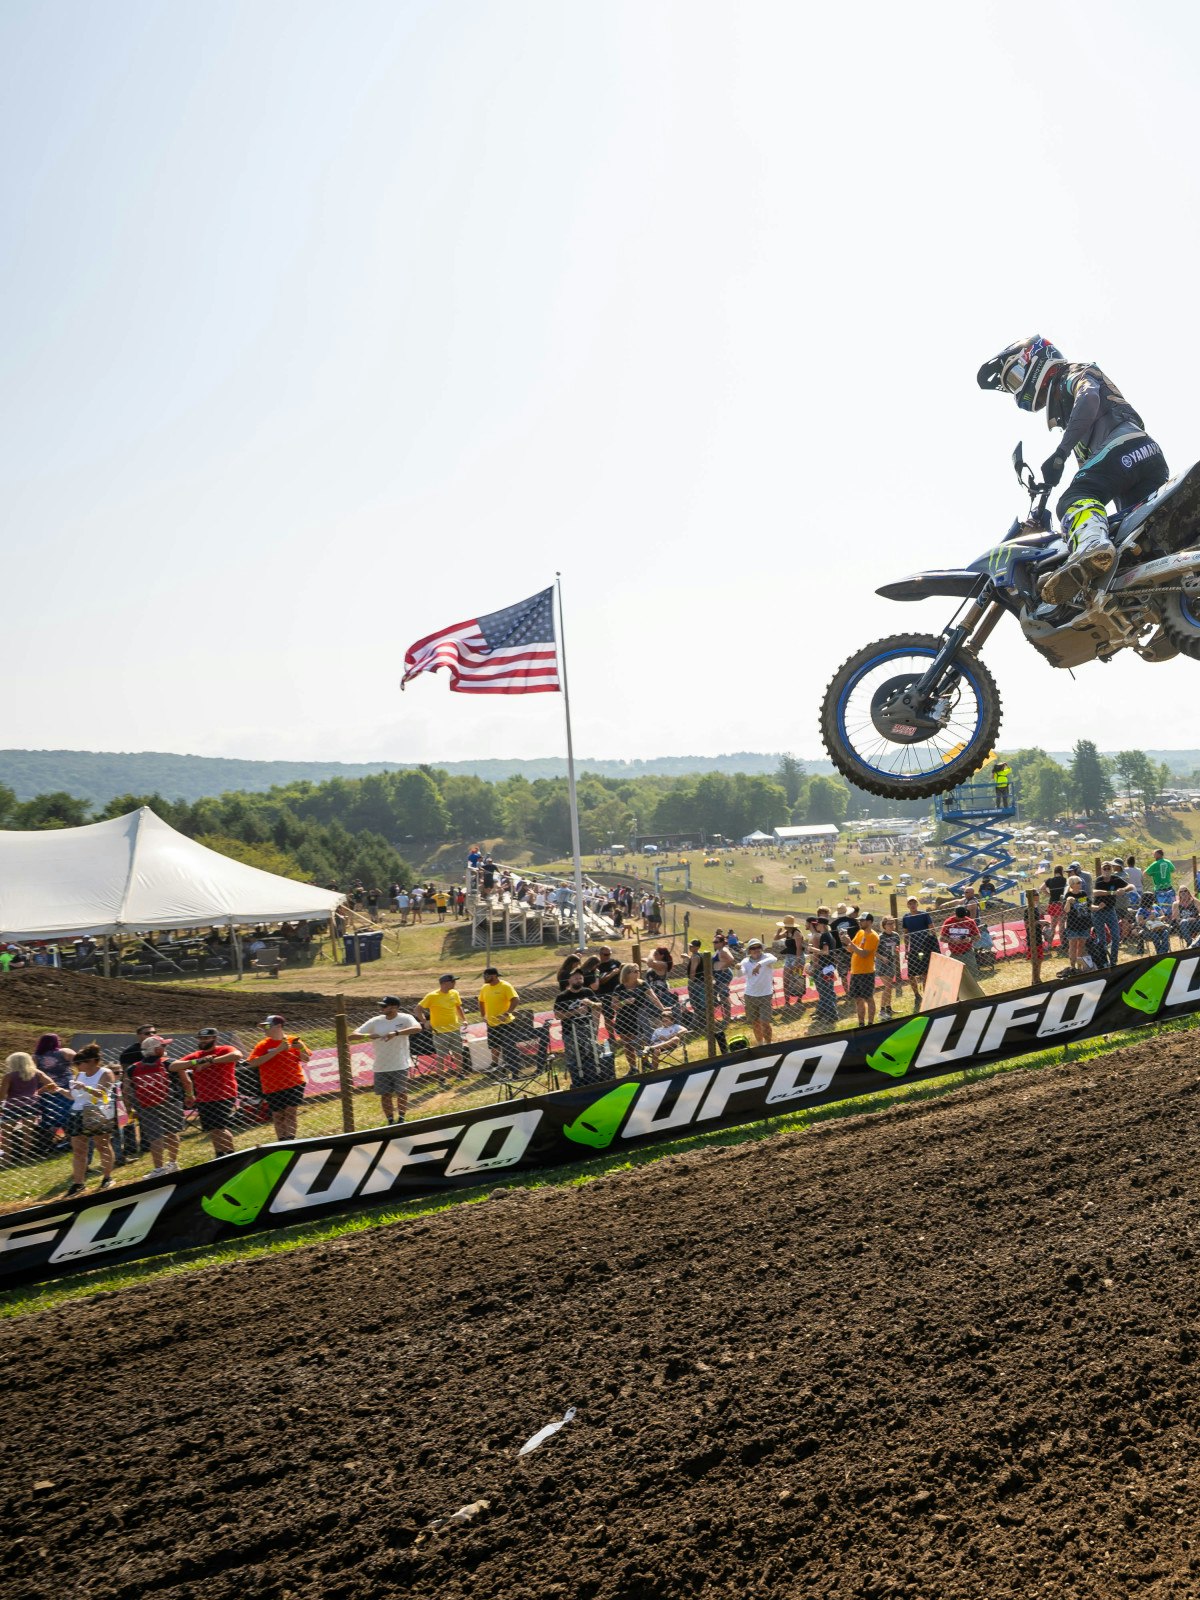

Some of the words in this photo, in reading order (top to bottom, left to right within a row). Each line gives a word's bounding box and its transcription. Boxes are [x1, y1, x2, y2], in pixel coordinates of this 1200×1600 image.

[914, 978, 1107, 1069] UFO
[1040, 1019, 1089, 1035] PLAST
[621, 1040, 849, 1139] UFO
[770, 1084, 827, 1101] PLAST
[269, 1109, 544, 1214] UFO
[450, 1156, 517, 1174] PLAST
[55, 1234, 143, 1260] PLAST
